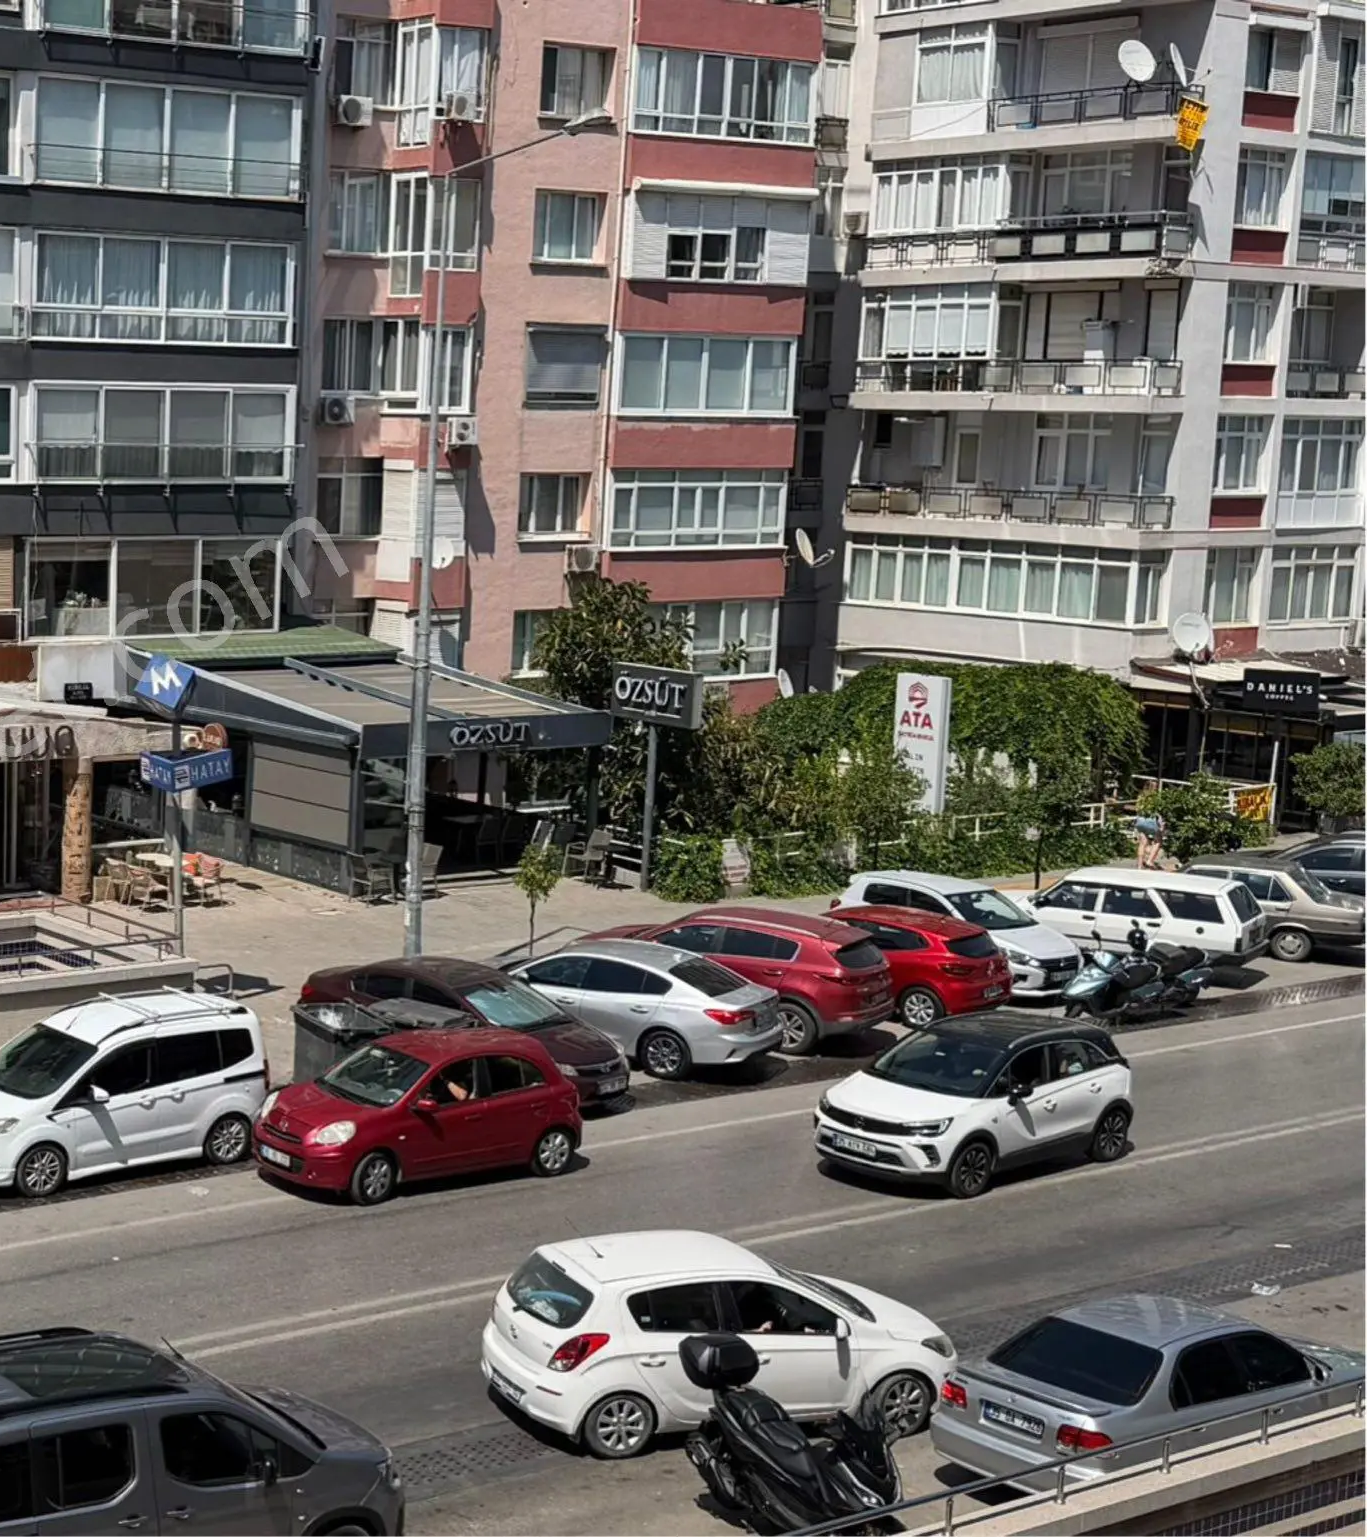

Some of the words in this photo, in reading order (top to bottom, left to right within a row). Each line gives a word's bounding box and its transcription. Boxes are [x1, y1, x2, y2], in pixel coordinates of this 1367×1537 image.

[149, 663, 183, 696] M
[615, 670, 688, 709] ÖZSÜT
[1246, 682, 1314, 695] DANIEL'S
[900, 710, 933, 729] ATA
[190, 757, 231, 782] HATAY
